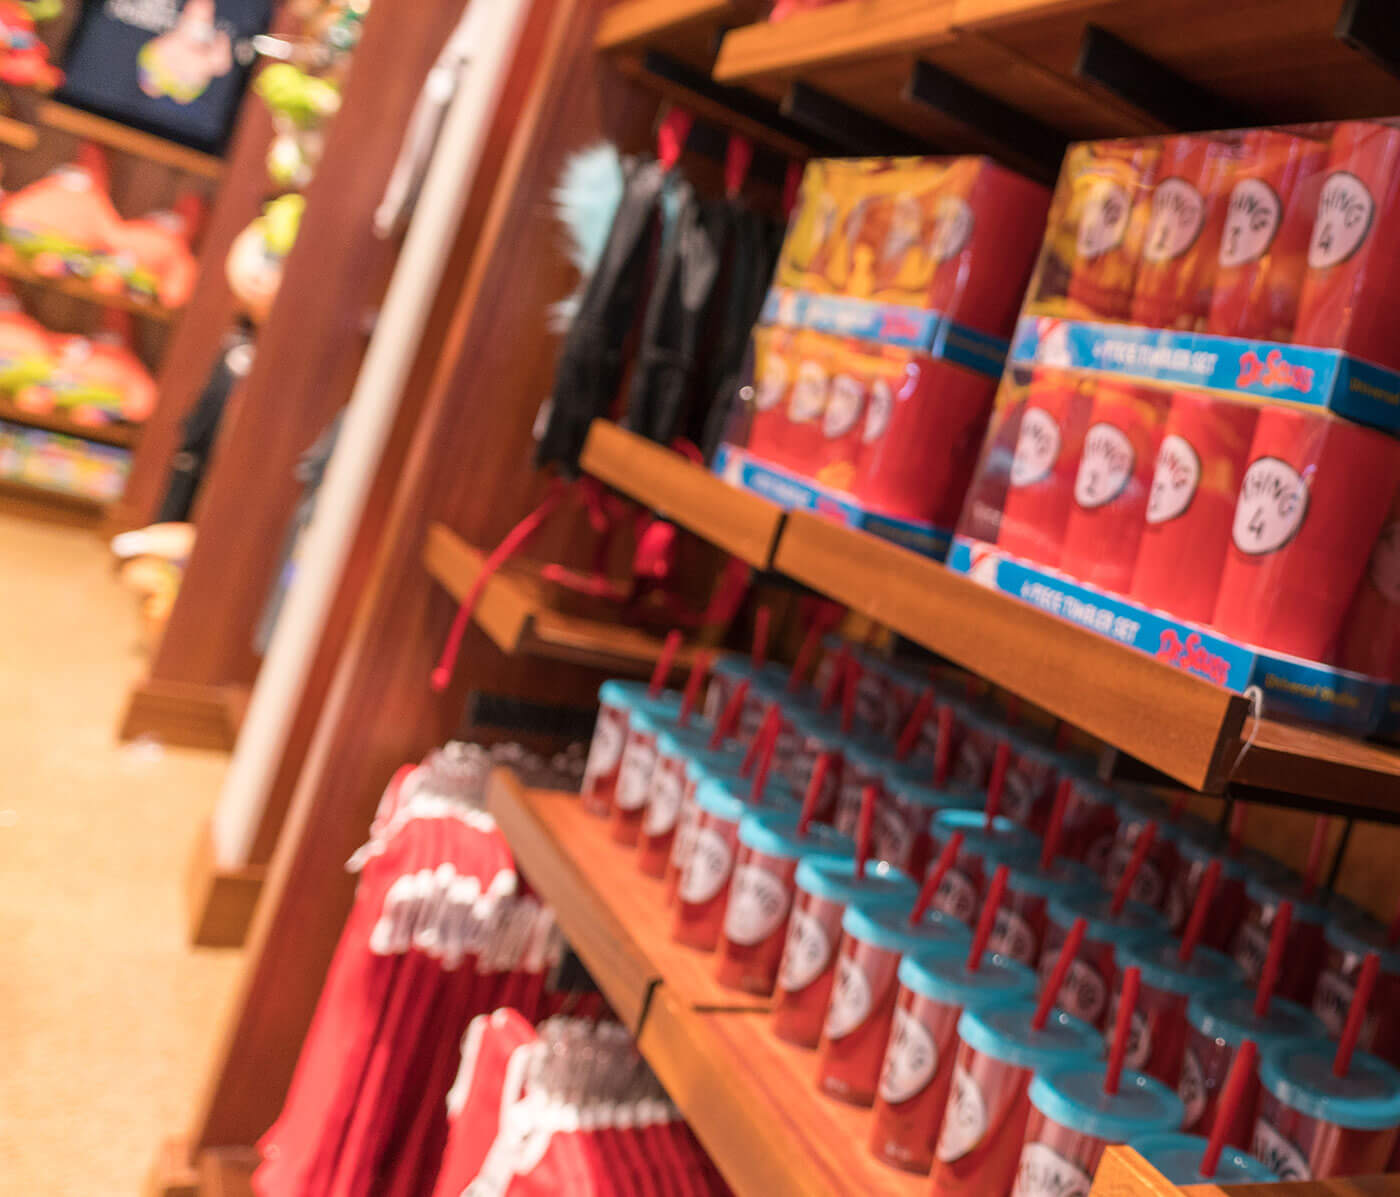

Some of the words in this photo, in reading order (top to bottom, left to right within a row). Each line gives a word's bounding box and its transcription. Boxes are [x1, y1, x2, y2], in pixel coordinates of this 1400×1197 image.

[1191, 351, 1218, 375] SET
[1248, 506, 1264, 541] 4
[1113, 615, 1141, 646] SET
